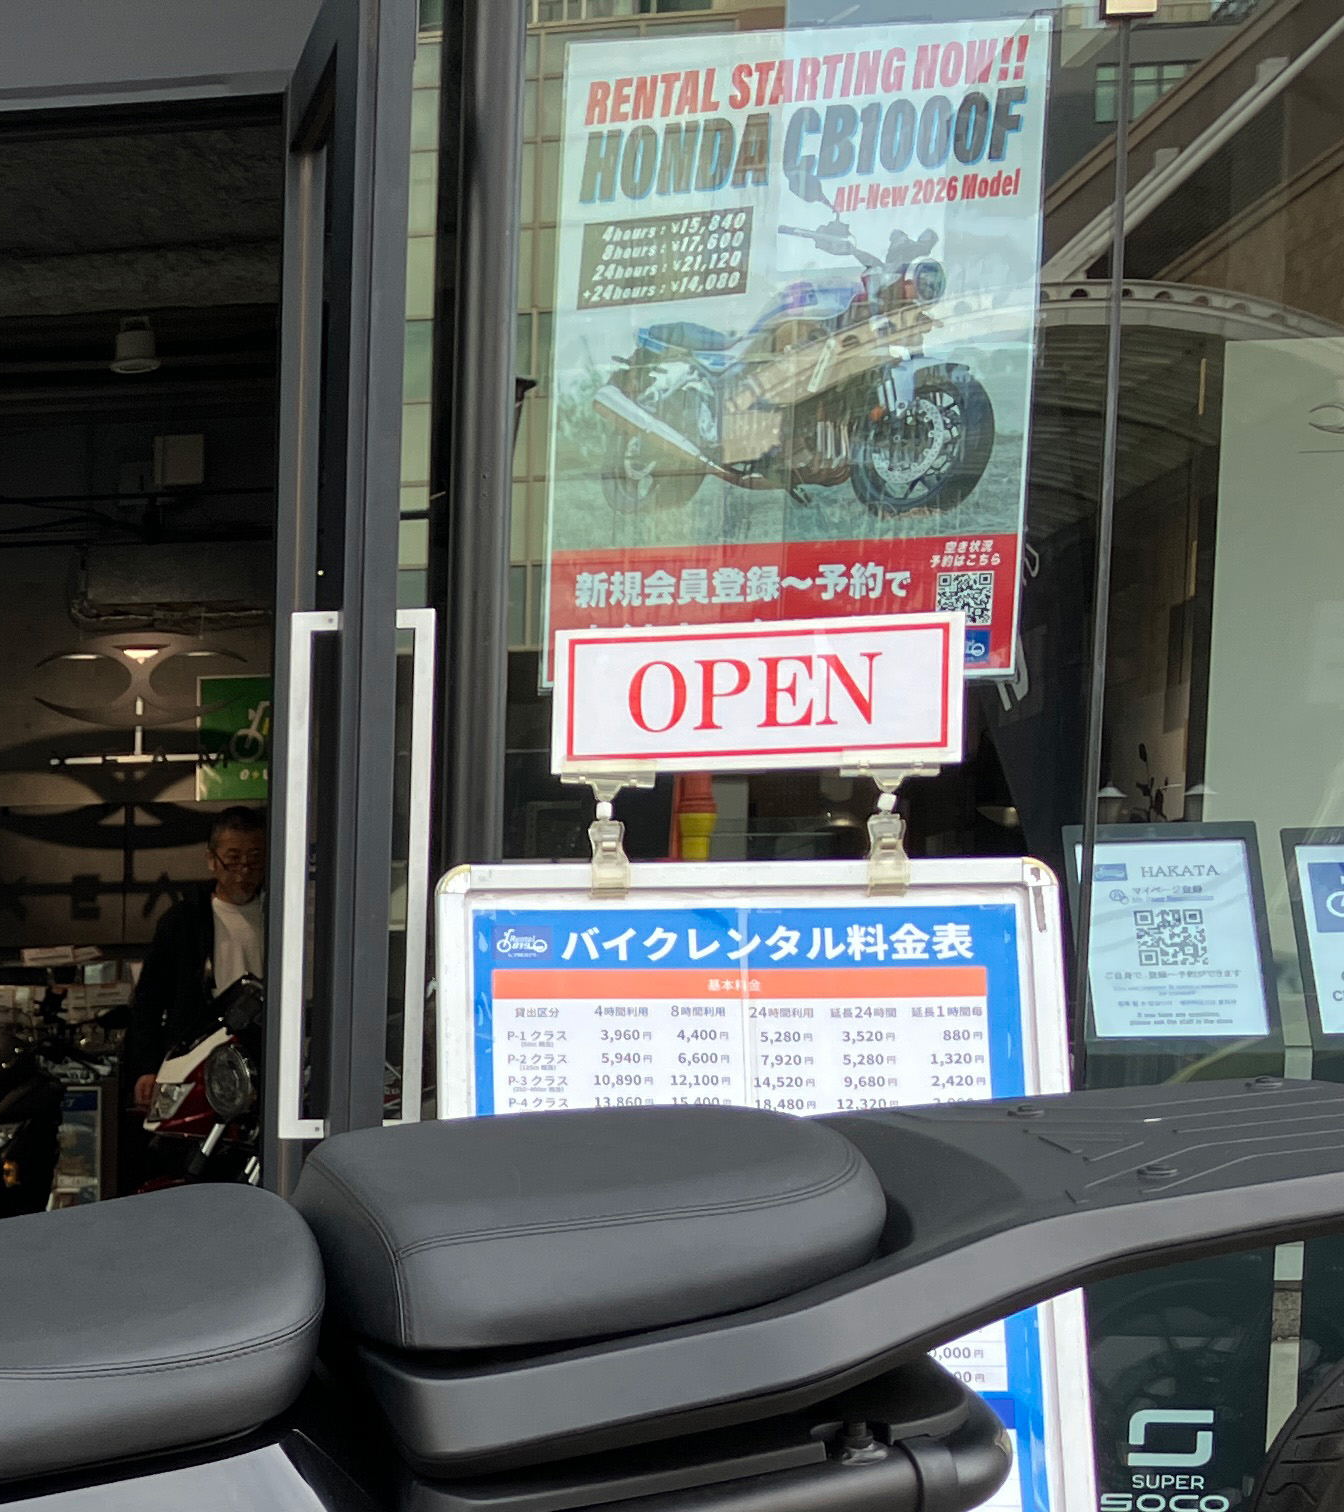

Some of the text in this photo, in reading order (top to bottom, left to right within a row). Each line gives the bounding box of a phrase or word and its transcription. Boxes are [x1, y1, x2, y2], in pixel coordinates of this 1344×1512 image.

[585, 34, 1029, 126] RENTAL STARTING NOW!!
[579, 86, 1029, 204] HONDA CB1000F
[833, 168, 1021, 213] All-New 2026 Model
[943, 540, 994, 554] 空き状況
[929, 552, 1001, 568] 予約はこちら
[627, 651, 883, 734] OPEN
[1141, 865, 1220, 878] HAKATA
[561, 923, 974, 961] バイクレンタル料金表
[708, 978, 761, 992] 基本料金
[514, 1005, 983, 1019] 貸出区分 4時間利用 8時間利用 24時間利用 延長24時間 延長1時間毎
[507, 1031, 526, 1041] P-1
[531, 1029, 568, 1041] クラス
[507, 1054, 527, 1064] P-2
[531, 1053, 568, 1064] クラス
[508, 1076, 527, 1086] P-3
[532, 1075, 569, 1086] クラス
[508, 1097, 527, 1108] P-4
[533, 1096, 569, 1108] クラス
[1132, 1474, 1205, 1490] SUPER
